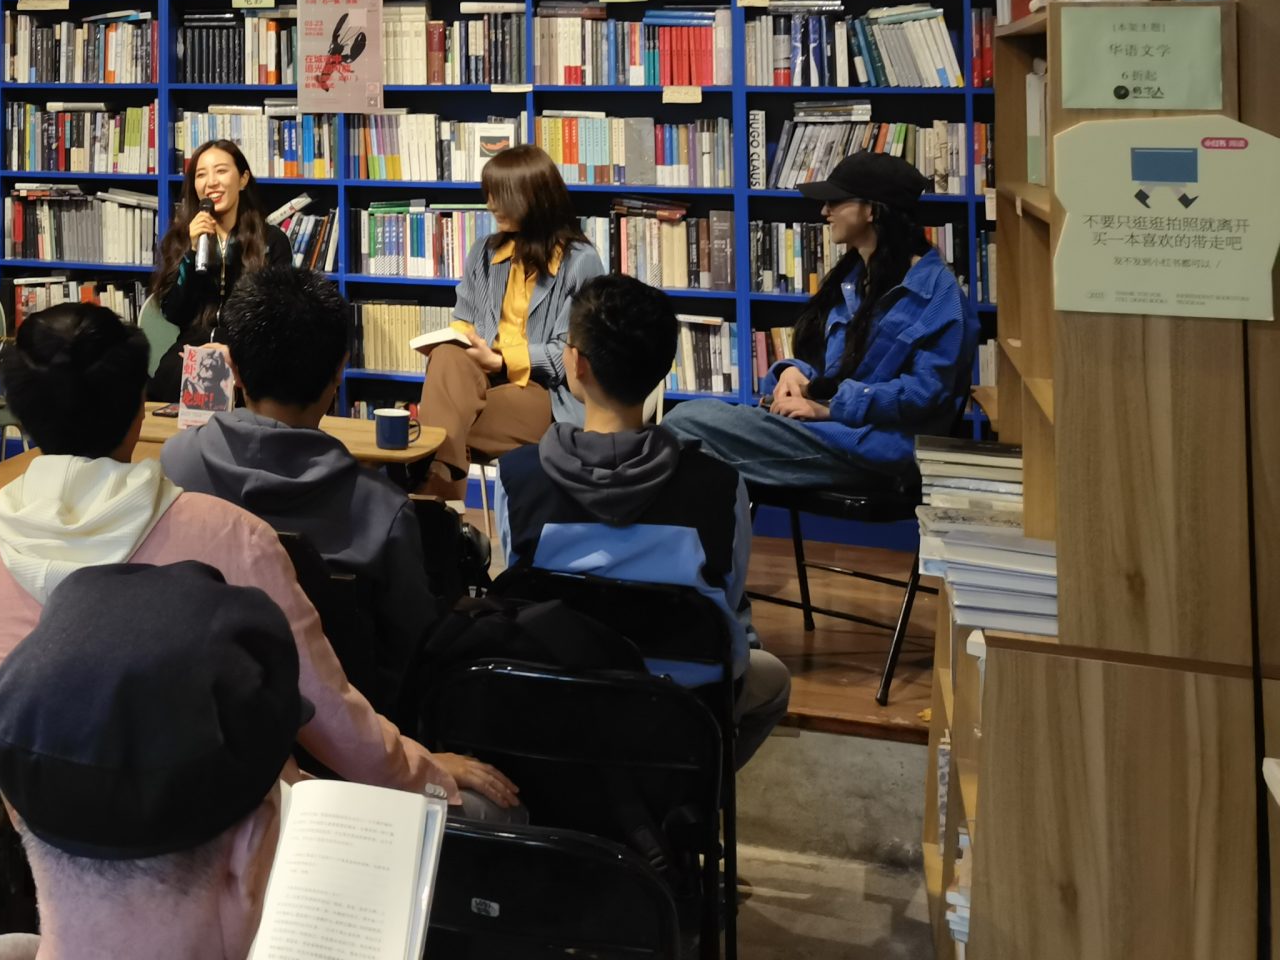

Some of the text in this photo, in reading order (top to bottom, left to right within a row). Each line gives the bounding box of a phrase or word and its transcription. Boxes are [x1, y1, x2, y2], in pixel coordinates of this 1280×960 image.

[1109, 43, 1171, 58] 华语文学
[749, 113, 761, 188] HUGO CLAUS
[1083, 214, 1251, 234] 不要只逛逛拍照就离开
[1093, 231, 1243, 251] 买一本喜欢的带走吧
